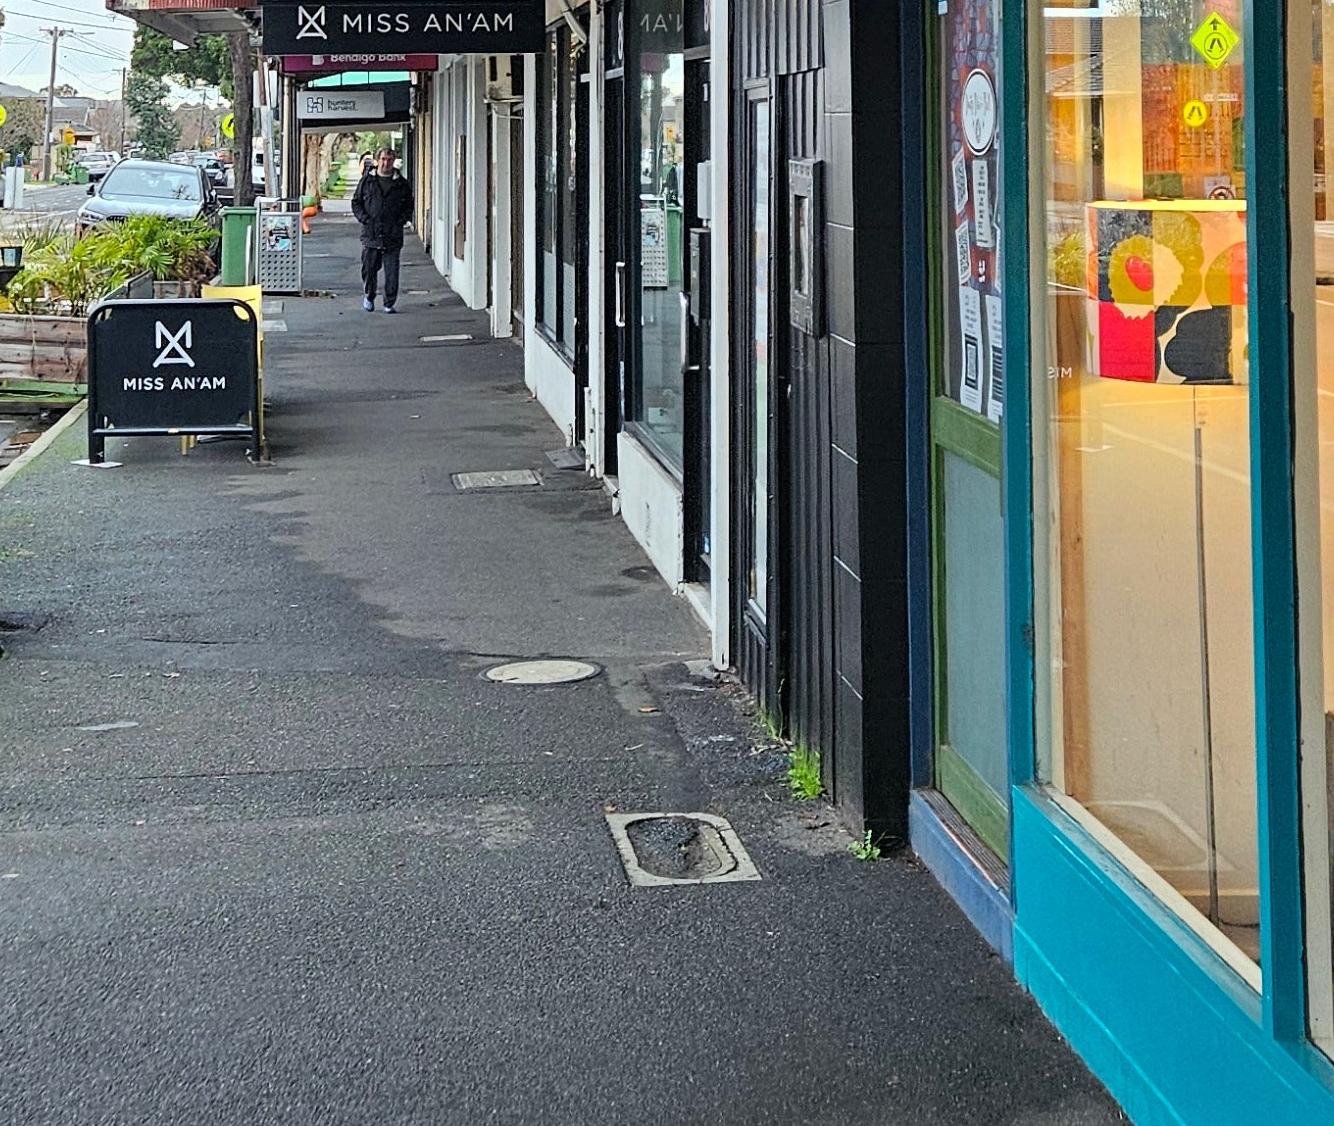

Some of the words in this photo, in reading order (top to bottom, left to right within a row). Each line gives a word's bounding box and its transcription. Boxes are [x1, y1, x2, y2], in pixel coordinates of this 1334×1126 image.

[342, 12, 411, 34] MISS
[423, 12, 514, 34] AN'AM
[122, 376, 166, 391] MISS
[170, 375, 227, 391] AN'AM
